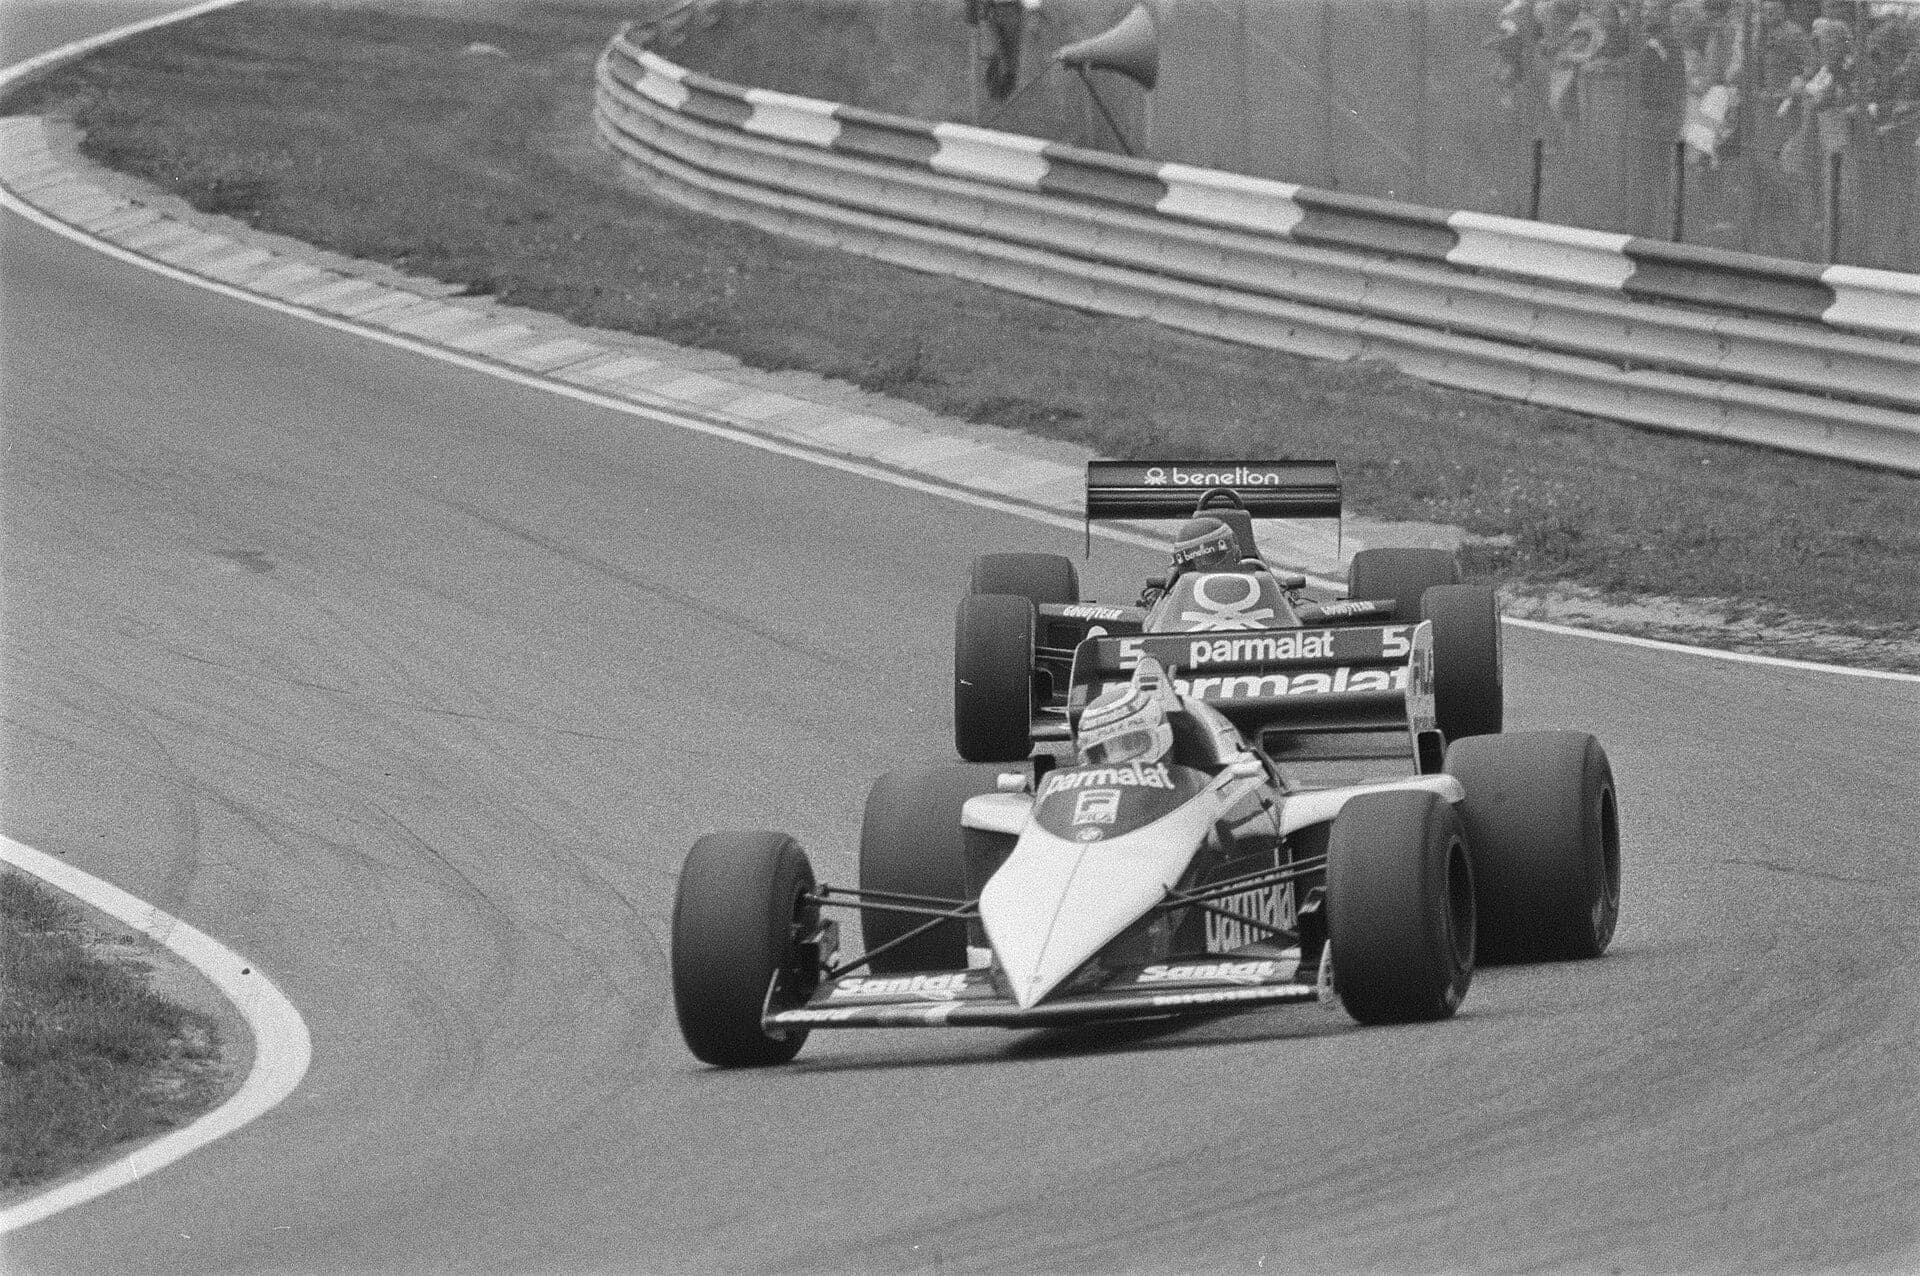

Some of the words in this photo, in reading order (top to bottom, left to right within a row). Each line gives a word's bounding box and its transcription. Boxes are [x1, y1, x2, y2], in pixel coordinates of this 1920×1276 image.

[1172, 466, 1279, 485] benetton
[1119, 637, 1147, 670] 5
[1189, 630, 1335, 669] parmalat
[1382, 626, 1411, 658] 5
[1043, 760, 1176, 796] parmalat
